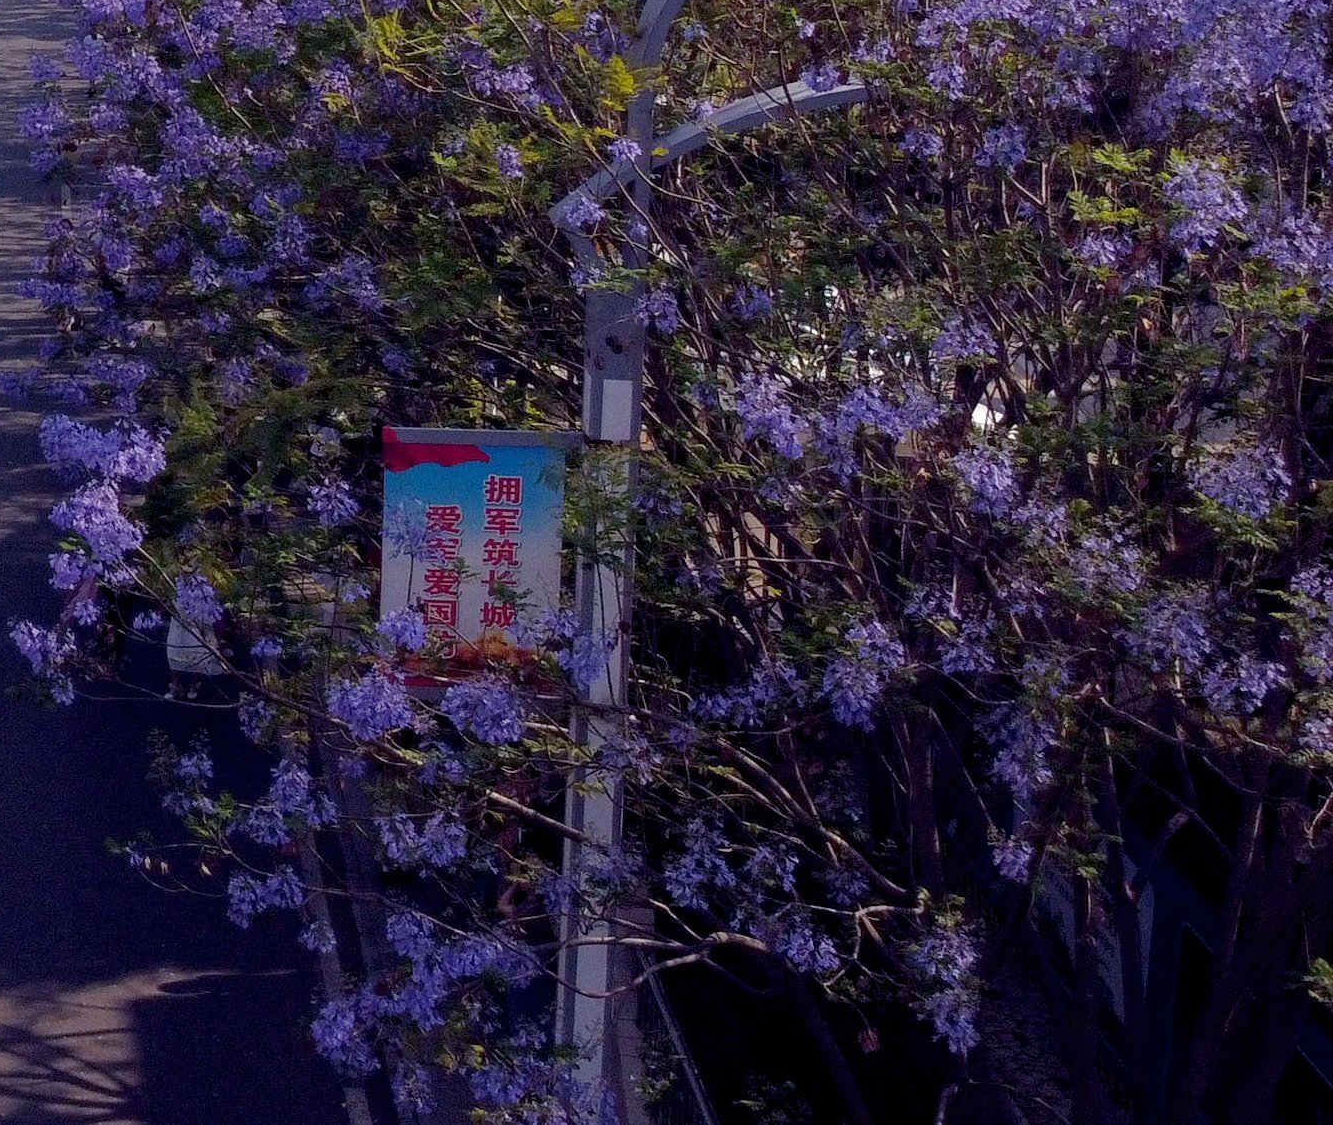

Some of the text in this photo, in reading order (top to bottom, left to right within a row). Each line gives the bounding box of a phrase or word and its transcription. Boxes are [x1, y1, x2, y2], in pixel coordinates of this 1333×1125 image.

[479, 475, 523, 629] 拥军筑长城
